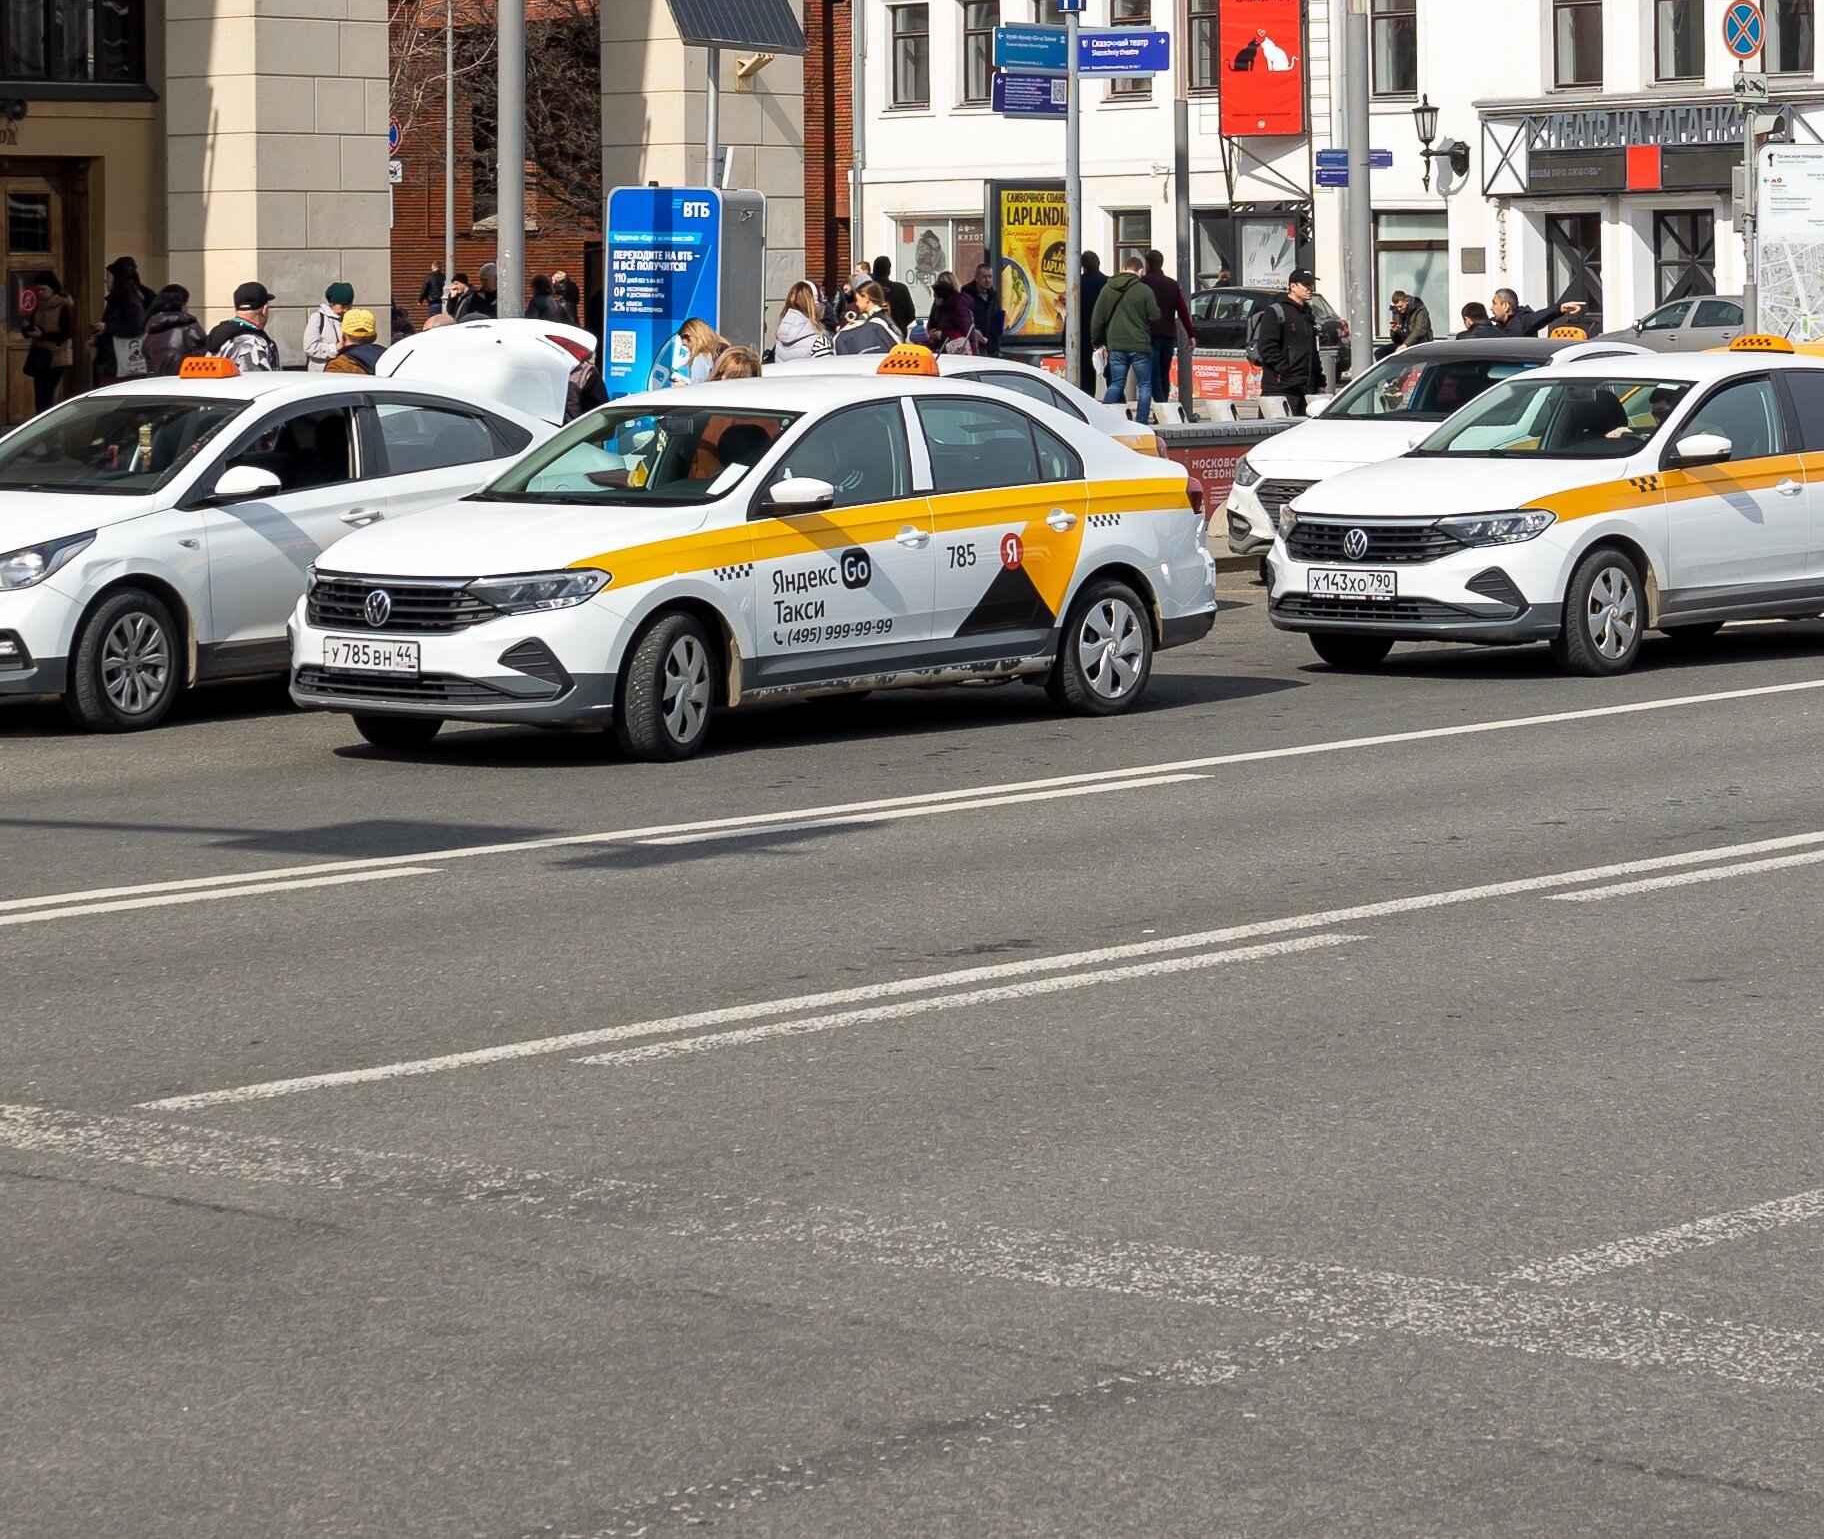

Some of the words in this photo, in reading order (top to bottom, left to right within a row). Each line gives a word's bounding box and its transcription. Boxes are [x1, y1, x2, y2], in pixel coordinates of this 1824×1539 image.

[1129, 39, 1149, 48] театр
[1551, 112, 1610, 149] ТЕАТР
[1615, 110, 1643, 146] НА
[1007, 193, 1045, 204] СЛИВОЧНОЕ
[683, 201, 711, 218] ВТБ
[613, 250, 663, 261] ПЕРЕХОДИТЕ
[664, 251, 676, 260] НА
[677, 251, 693, 261] ВТБ
[612, 261, 620, 270] И
[620, 259, 636, 271] ВСЁ
[636, 261, 687, 272] ПОЛУЧИТСЯ!
[614, 272, 627, 284] 110
[1191, 457, 1237, 469] МОСКОВС
[946, 543, 976, 569] 785
[772, 566, 838, 595] Яндекс
[844, 559, 868, 582] Go
[1313, 573, 1367, 592] Х143ХО
[1369, 573, 1391, 588] 790
[773, 599, 825, 625] Такси
[787, 625, 822, 648] (495)
[825, 618, 893, 641] 999-99-99
[331, 643, 392, 667] У785ВН
[396, 645, 412, 662] 44
